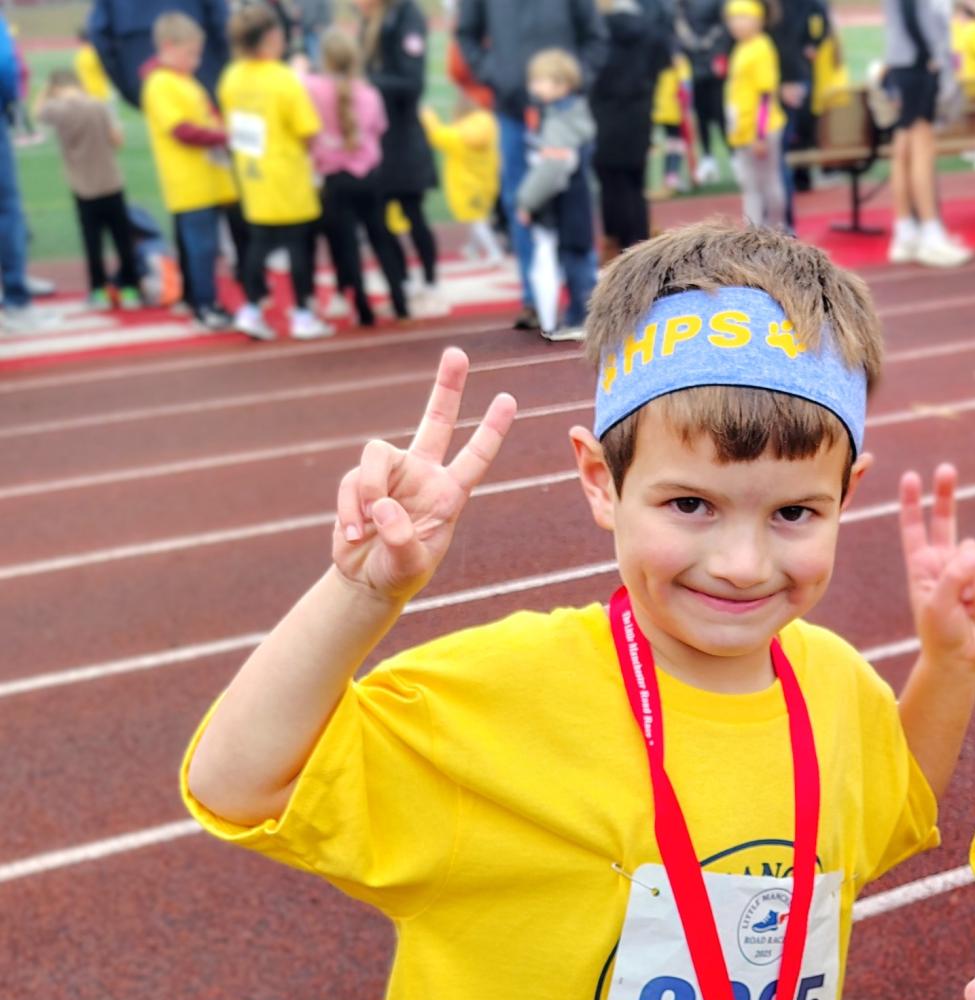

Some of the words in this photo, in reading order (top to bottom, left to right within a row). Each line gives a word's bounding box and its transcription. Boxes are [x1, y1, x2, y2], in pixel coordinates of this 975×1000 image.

[623, 310, 752, 375] HPS
[628, 642, 646, 689] Manchester
[640, 689, 652, 714] Road
[742, 899, 760, 929] LITTLE
[743, 936, 766, 945] ROAD
[767, 936, 785, 945] RAC
